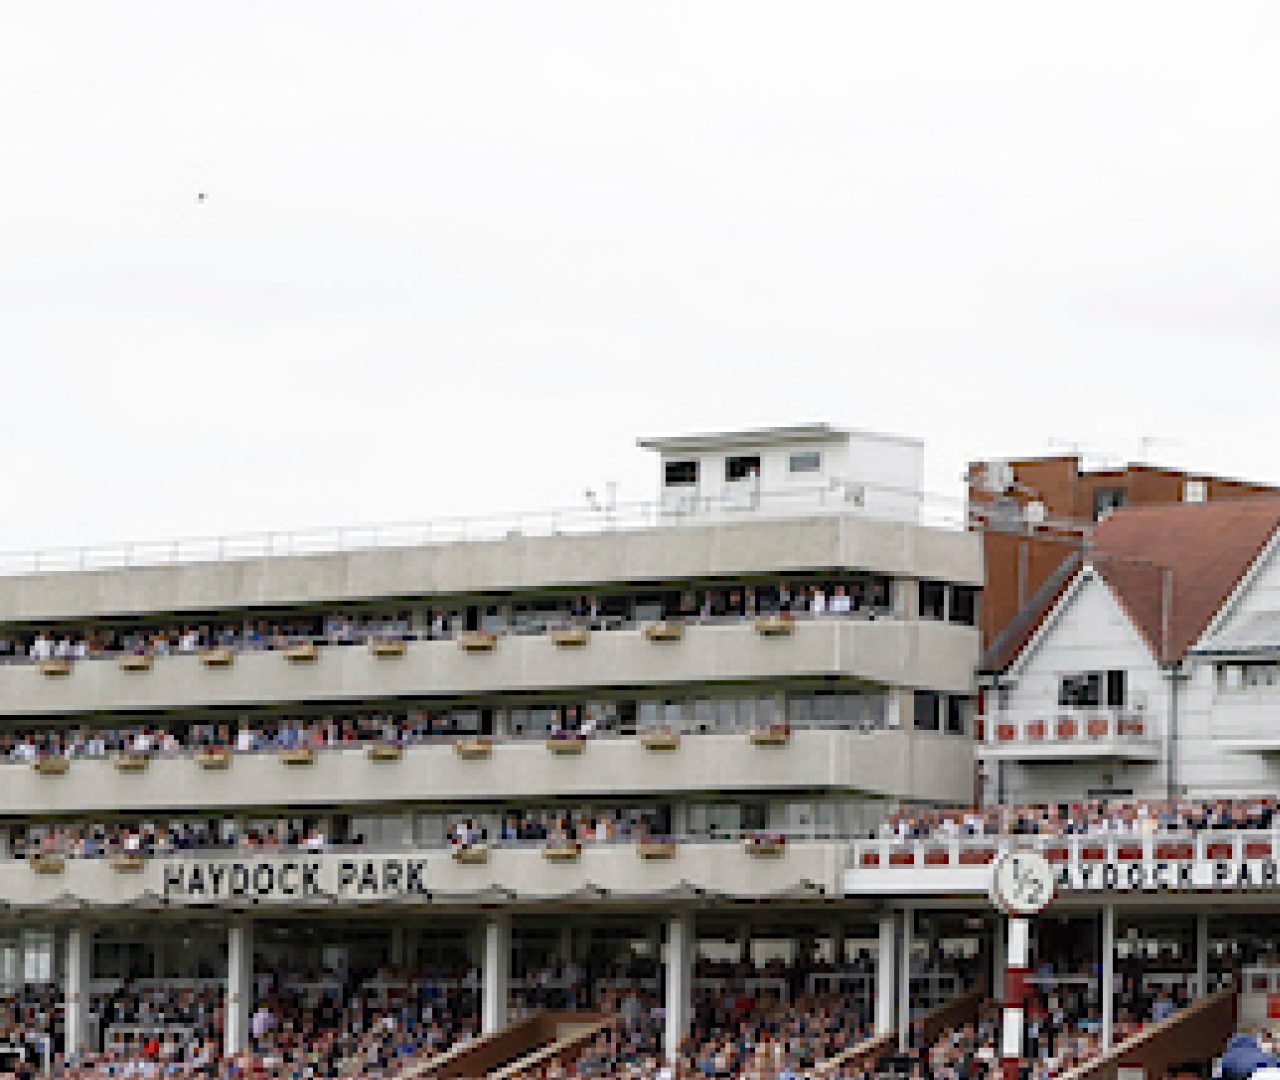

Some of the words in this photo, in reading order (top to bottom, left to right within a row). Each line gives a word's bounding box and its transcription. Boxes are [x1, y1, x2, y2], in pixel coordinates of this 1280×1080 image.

[164, 861, 320, 896] HAYDOCK
[339, 858, 429, 894] PARK
[1058, 862, 1195, 890] AYDOCK
